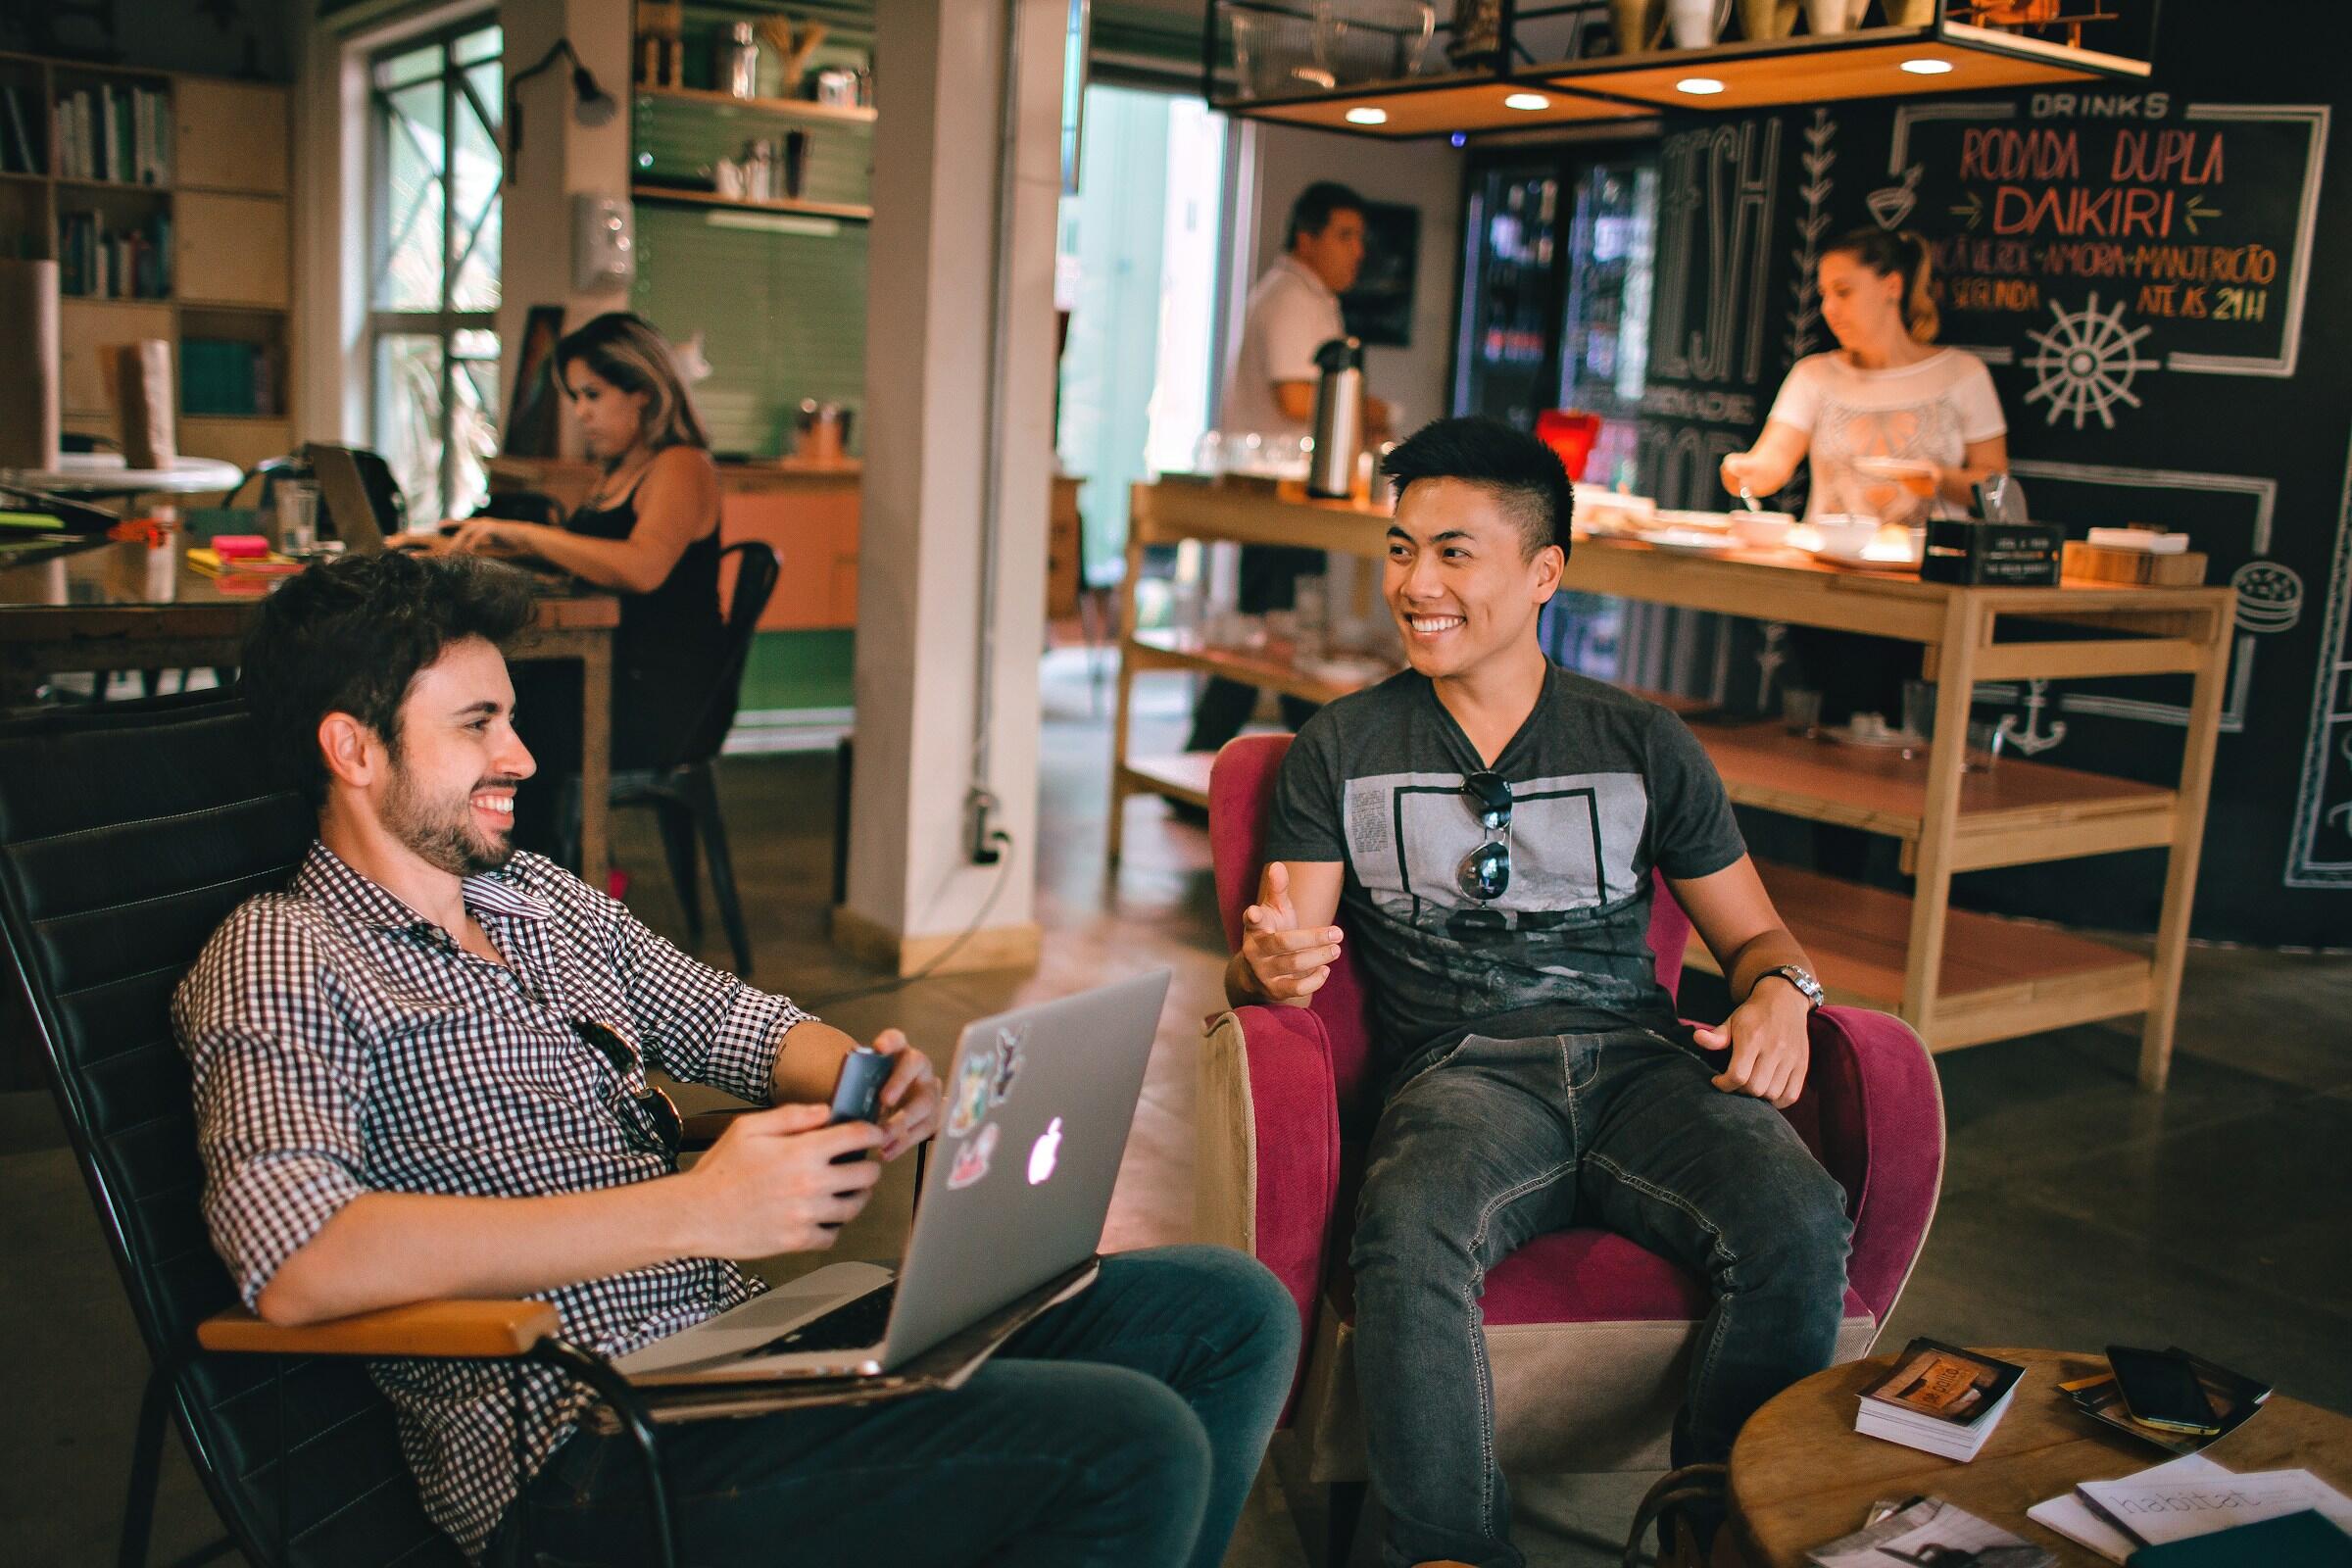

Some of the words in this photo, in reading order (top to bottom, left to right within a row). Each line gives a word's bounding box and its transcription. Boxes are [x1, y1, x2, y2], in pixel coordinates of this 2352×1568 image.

[2031, 92, 2171, 119] DRINKS
[1959, 126, 2080, 181] RODADA
[2110, 127, 2225, 185] DUPLA
[1992, 185, 2175, 238] DAIKIRI
[2041, 241, 2127, 278] AMORA
[2212, 285, 2268, 322] 21H
[2110, 1488, 2262, 1516] habitat
